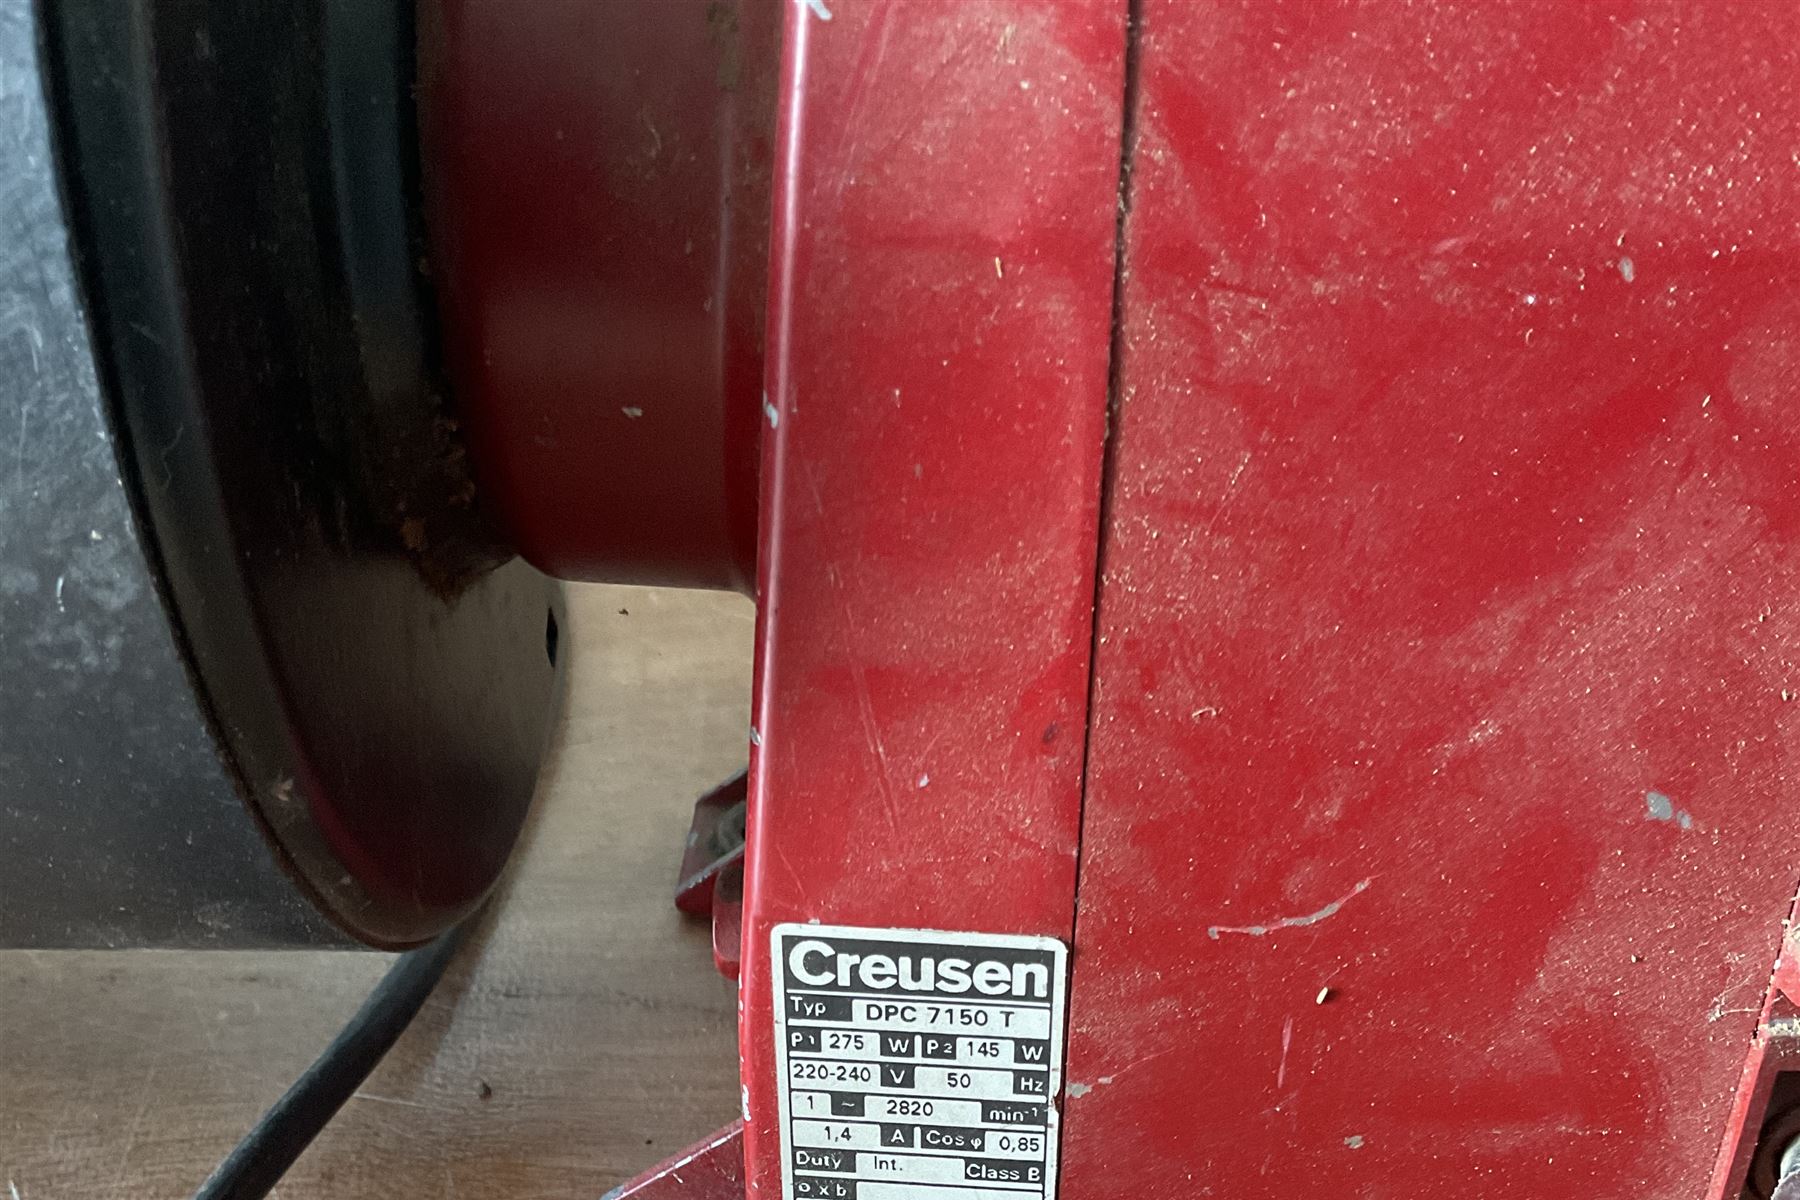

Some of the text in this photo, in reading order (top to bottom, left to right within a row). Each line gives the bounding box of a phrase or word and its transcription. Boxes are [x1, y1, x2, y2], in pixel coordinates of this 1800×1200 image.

[789, 940, 1048, 997] Creusen
[790, 997, 1015, 1027] Typ DPC 7150 T
[829, 1034, 864, 1050] 275
[889, 1038, 909, 1053] W
[966, 1042, 999, 1057] 145
[1022, 1046, 1043, 1061] W
[793, 1064, 1043, 1091] 220-240 V 50 Hz
[887, 1100, 933, 1116] 2820
[824, 1126, 852, 1141] 1,4
[891, 1130, 904, 1143] A
[926, 1131, 964, 1146] Cos
[999, 1136, 1039, 1152] 0,85
[796, 1151, 1040, 1181] Duty Int. Class B
